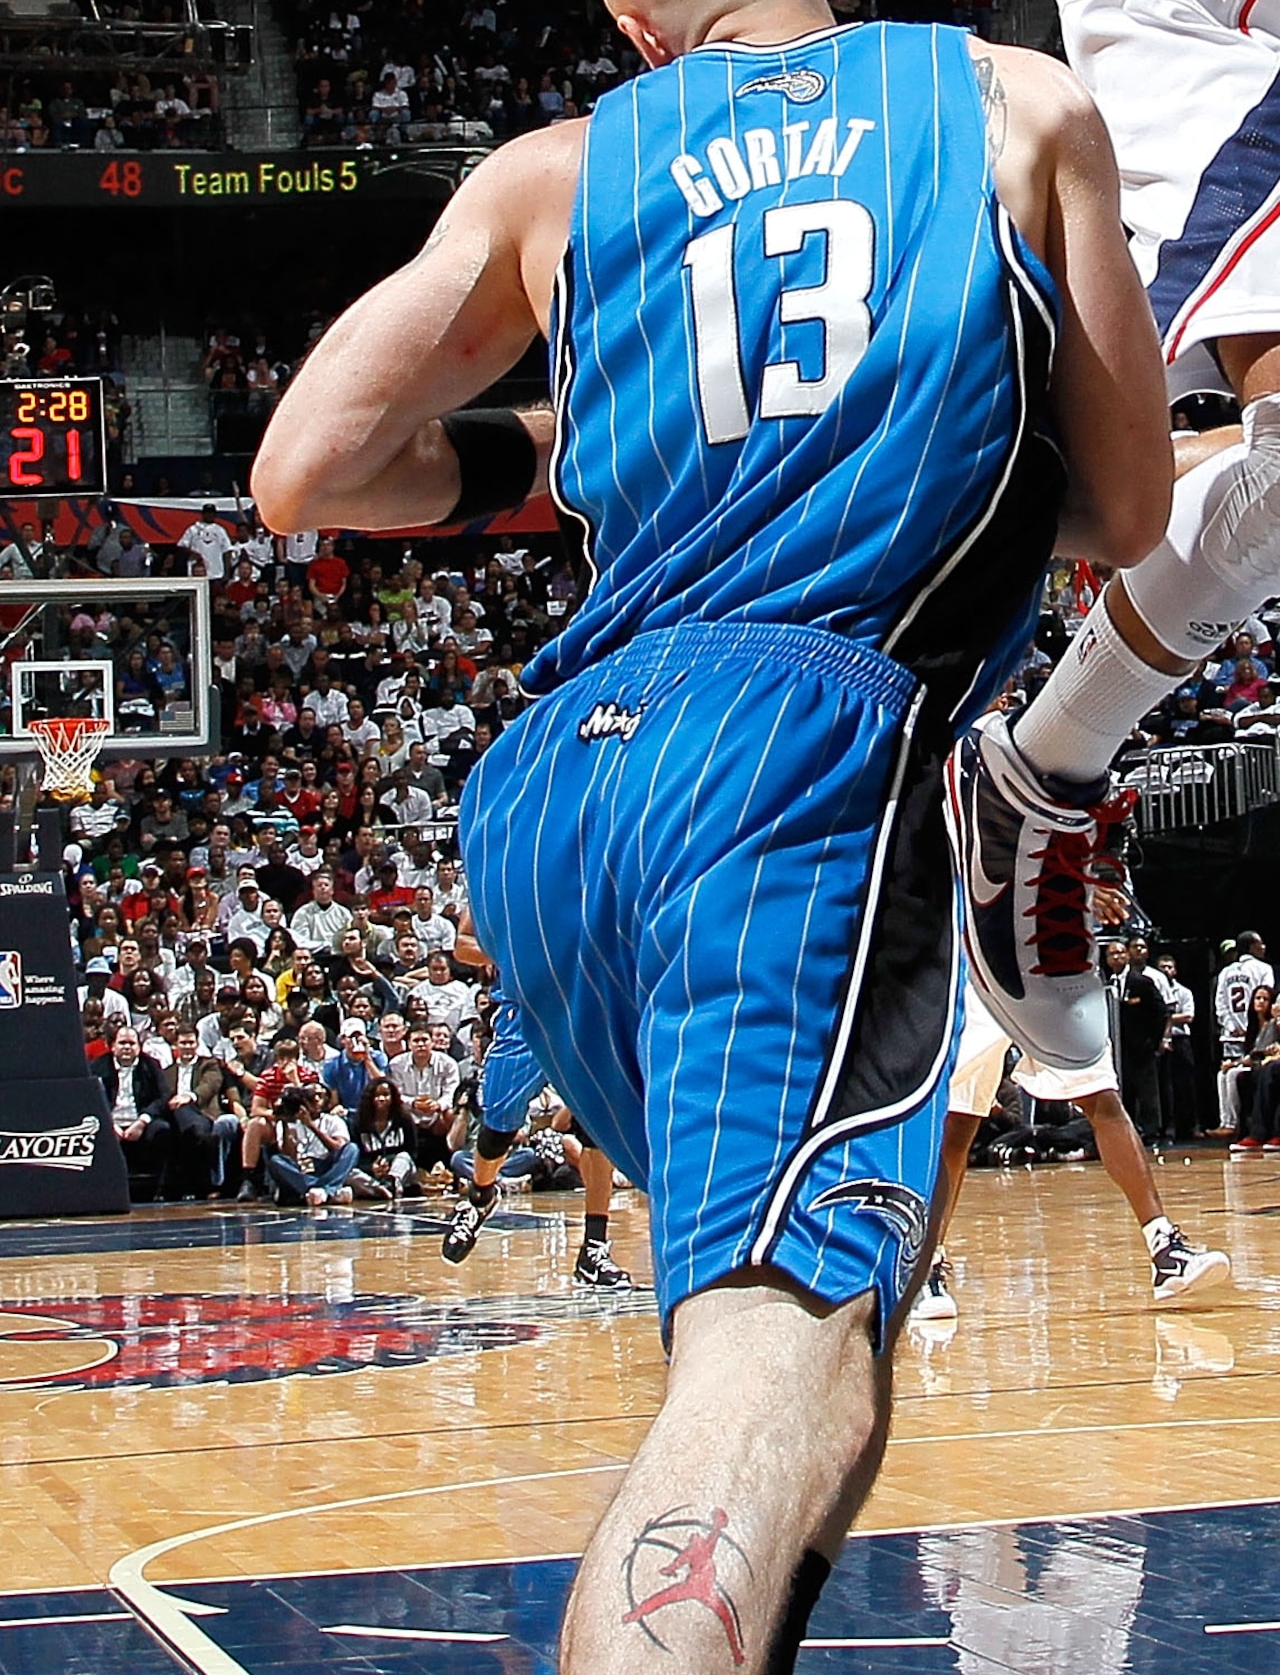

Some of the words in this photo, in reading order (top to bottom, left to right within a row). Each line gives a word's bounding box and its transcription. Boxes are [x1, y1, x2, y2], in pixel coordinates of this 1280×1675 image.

[100, 161, 142, 197] 48
[175, 164, 249, 195] Team
[259, 163, 335, 194] Fouls
[340, 161, 358, 192] 5
[670, 117, 876, 217] GORTAT
[683, 198, 875, 445] 13
[18, 391, 87, 423] 2:28
[9, 426, 82, 485] 21
[0, 881, 53, 895] SPALDING
[1230, 986, 1246, 1013] 2
[0, 1135, 95, 1158] AYOFFS
